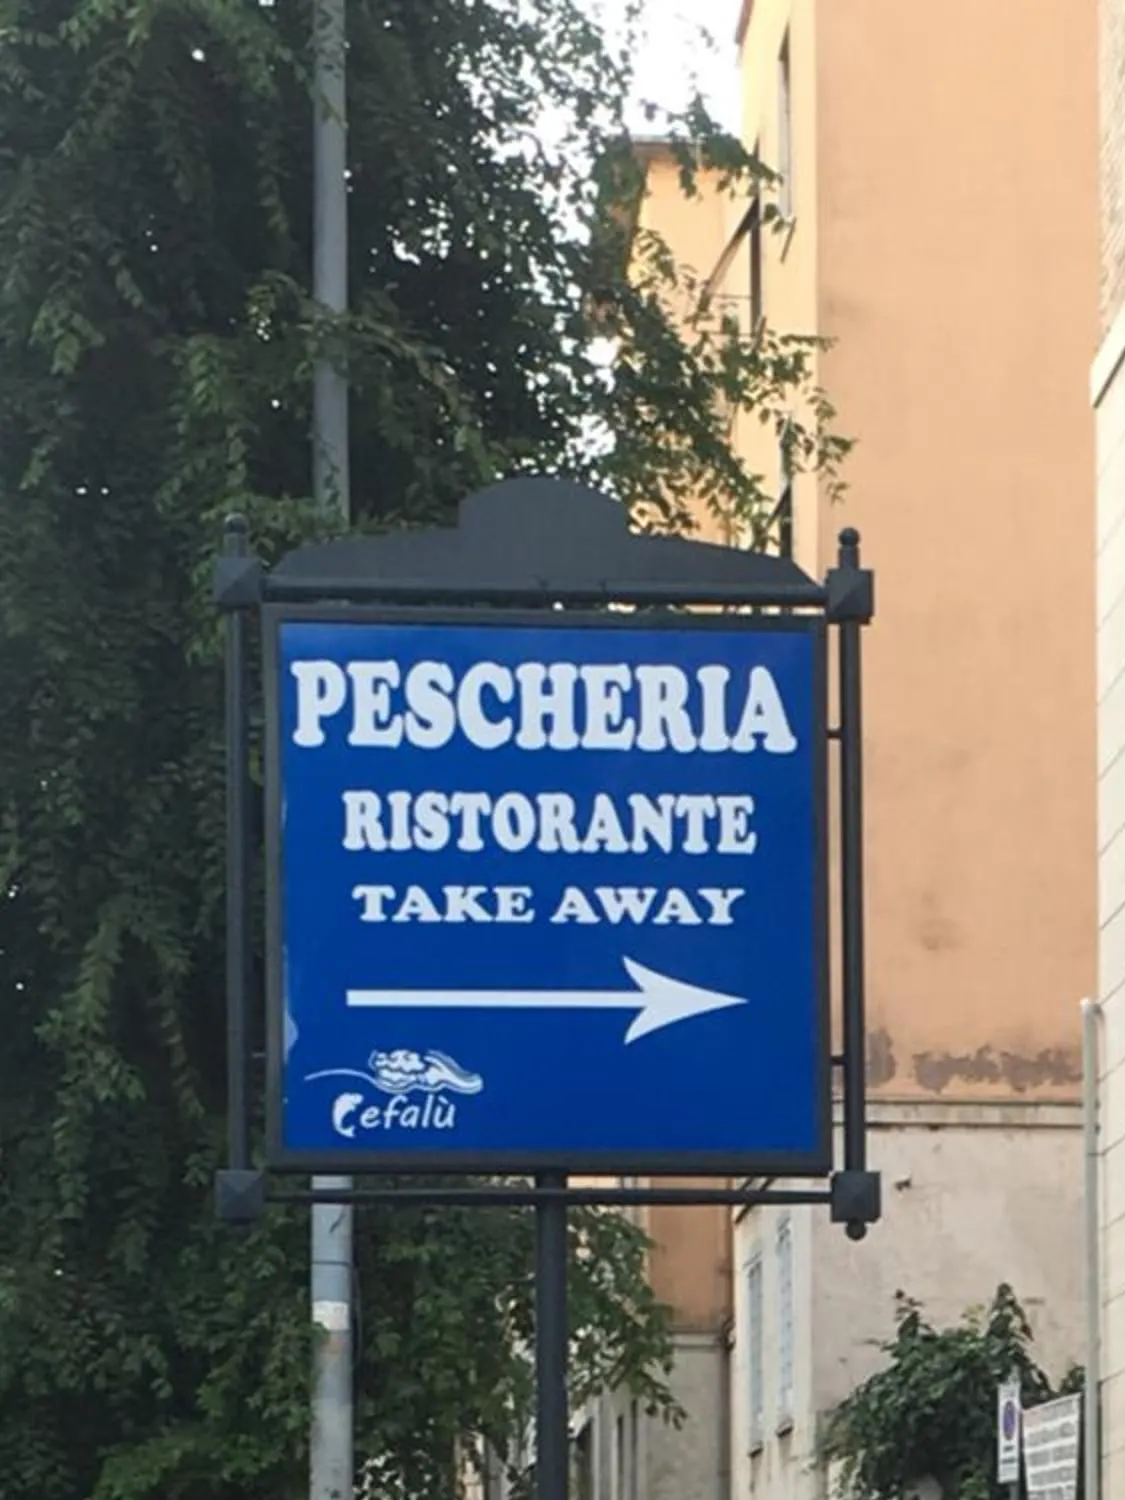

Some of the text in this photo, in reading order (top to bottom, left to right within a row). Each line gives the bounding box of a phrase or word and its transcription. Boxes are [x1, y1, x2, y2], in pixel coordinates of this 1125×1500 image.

[291, 660, 797, 753] PESCHERIA
[342, 790, 756, 854] RISTORANTE
[352, 885, 745, 924] TAKE AWAY
[332, 1092, 456, 1137] Cefalù
